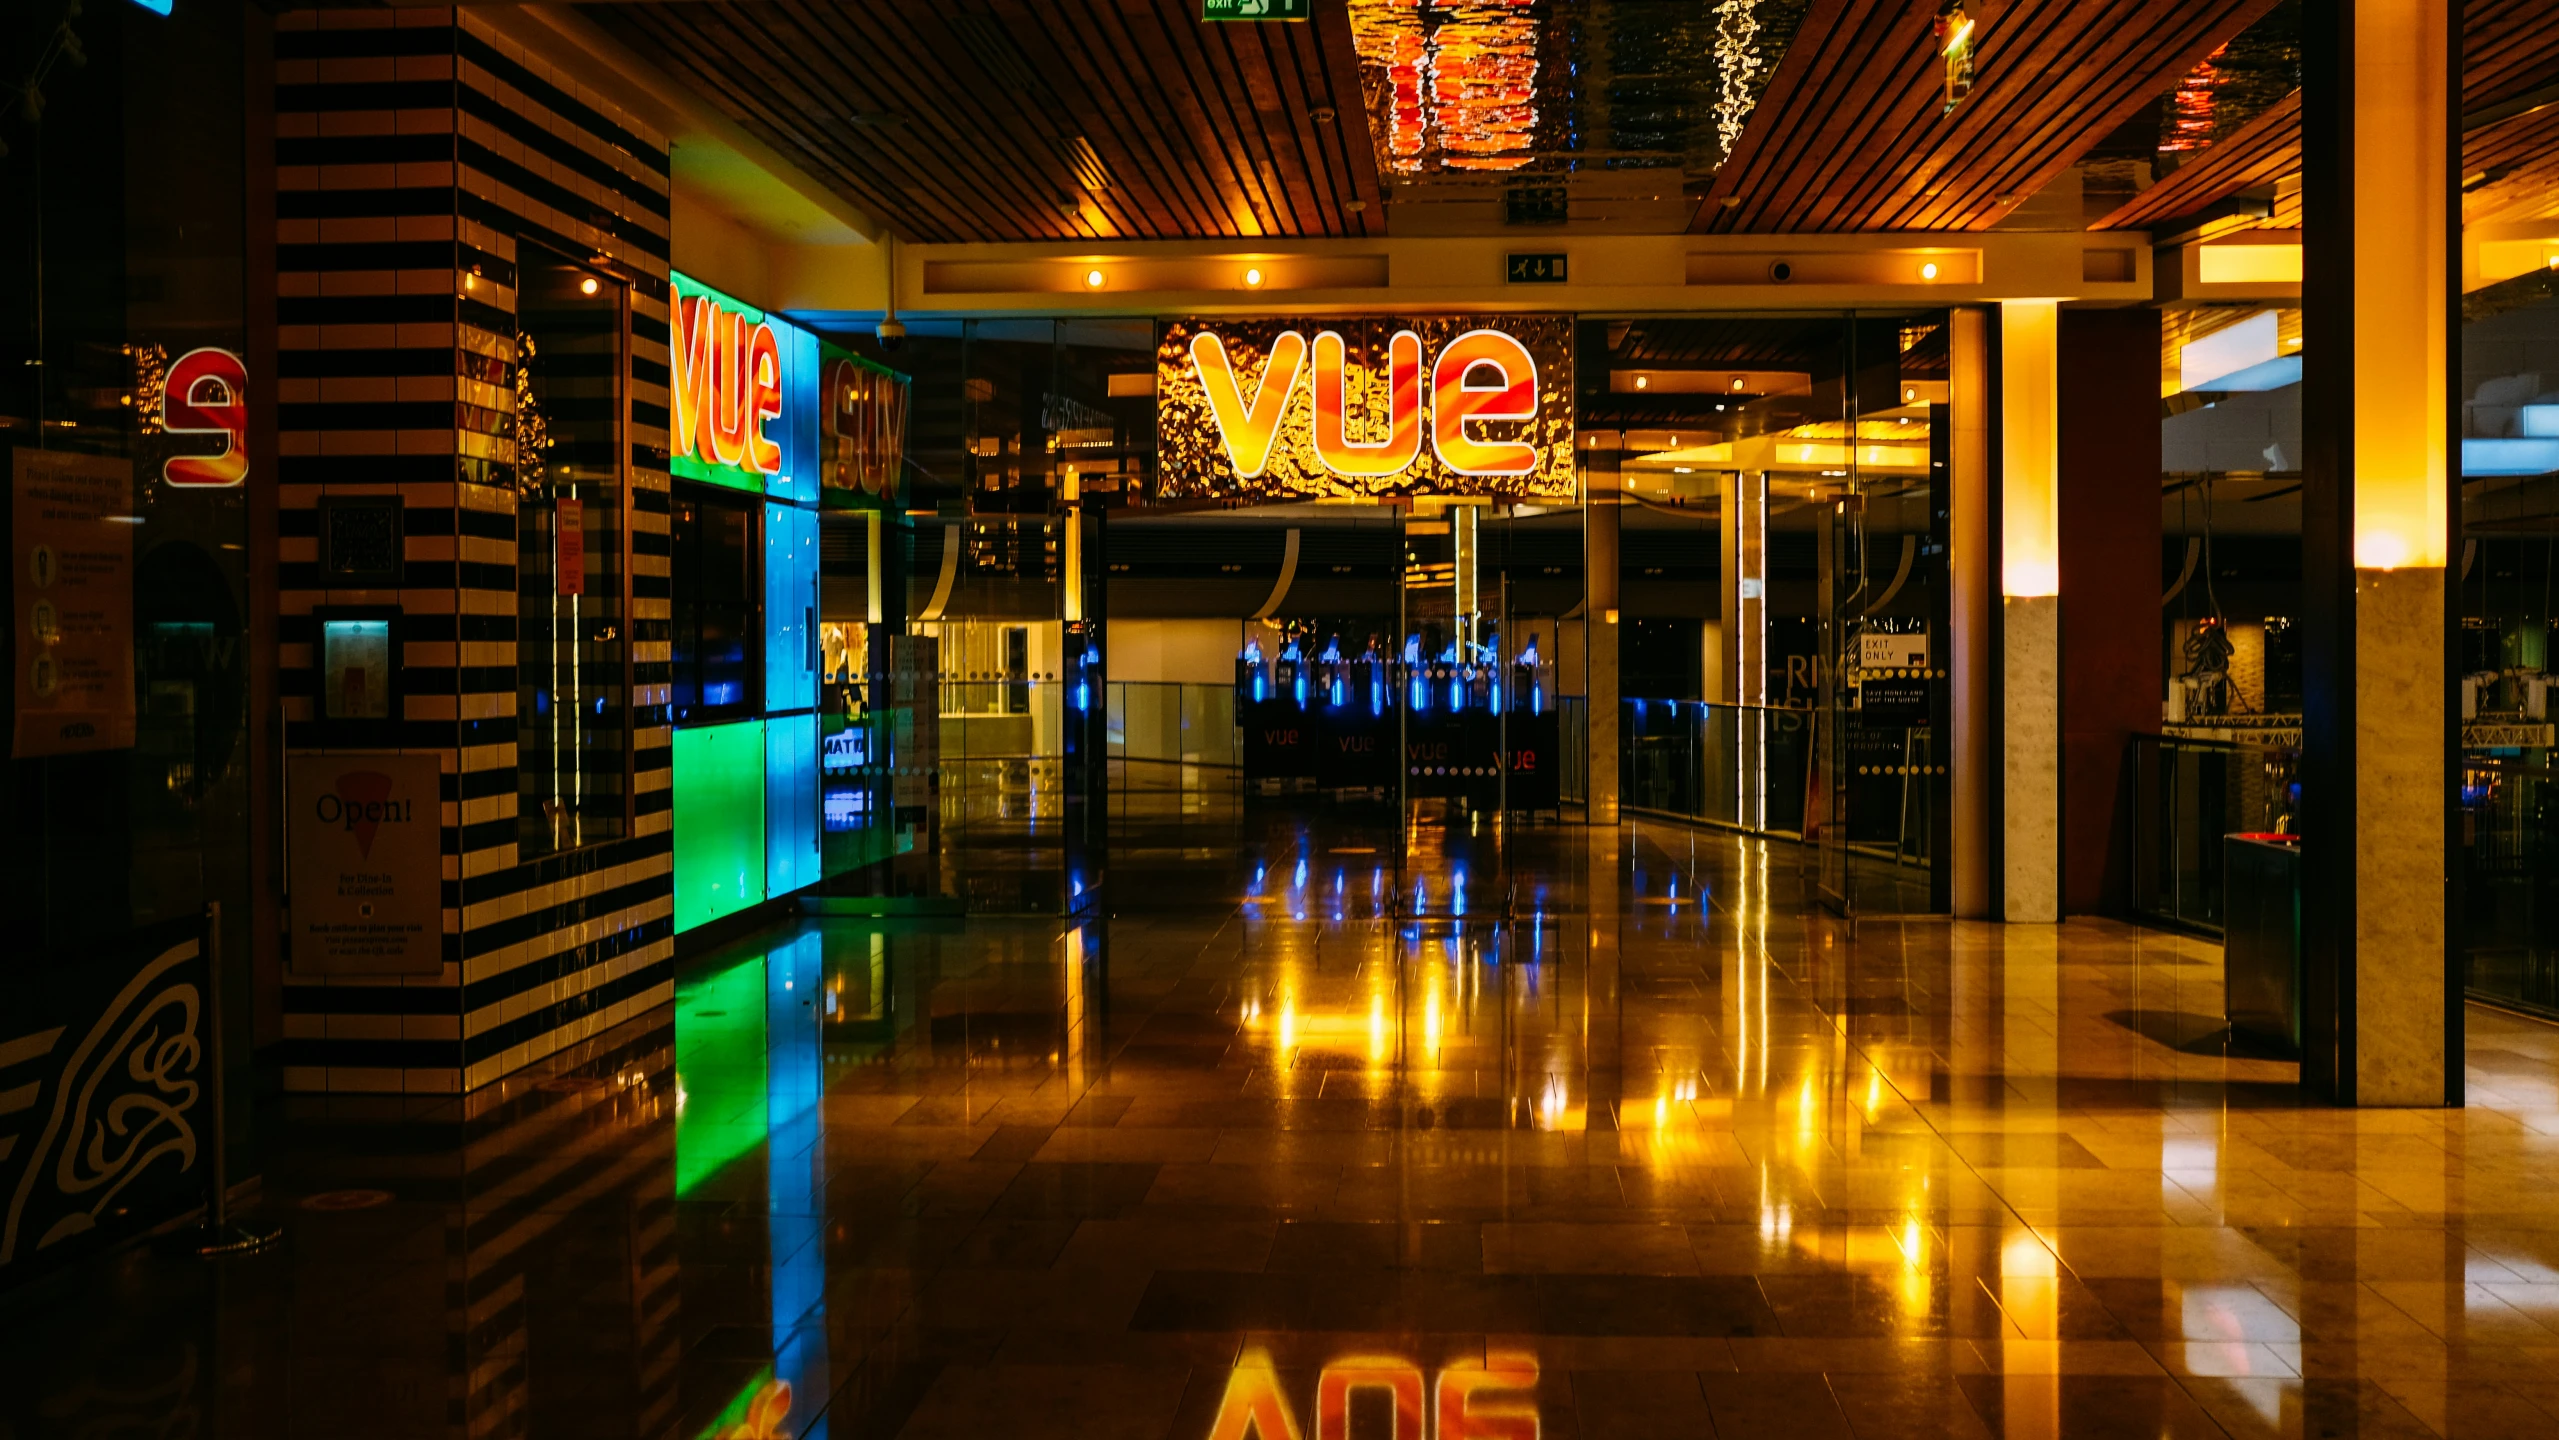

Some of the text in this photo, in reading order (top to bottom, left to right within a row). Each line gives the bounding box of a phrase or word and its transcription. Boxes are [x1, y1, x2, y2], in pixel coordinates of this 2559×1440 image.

[670, 282, 782, 476] vue
[1190, 329, 1539, 479] vue
[1865, 638, 1889, 650] EXIT
[1865, 650, 1894, 661] ONLY
[1865, 689, 1924, 697] SAVE MONEY AND
[1884, 697, 1896, 705] THE
[1897, 697, 1921, 705] QUEUE
[1264, 727, 1300, 746] vue
[1338, 733, 1376, 754] vue
[1407, 741, 1449, 761] vue
[316, 794, 412, 831] Open!
[340, 872, 355, 883] For
[347, 885, 394, 896] Collection
[309, 923, 329, 933] Book
